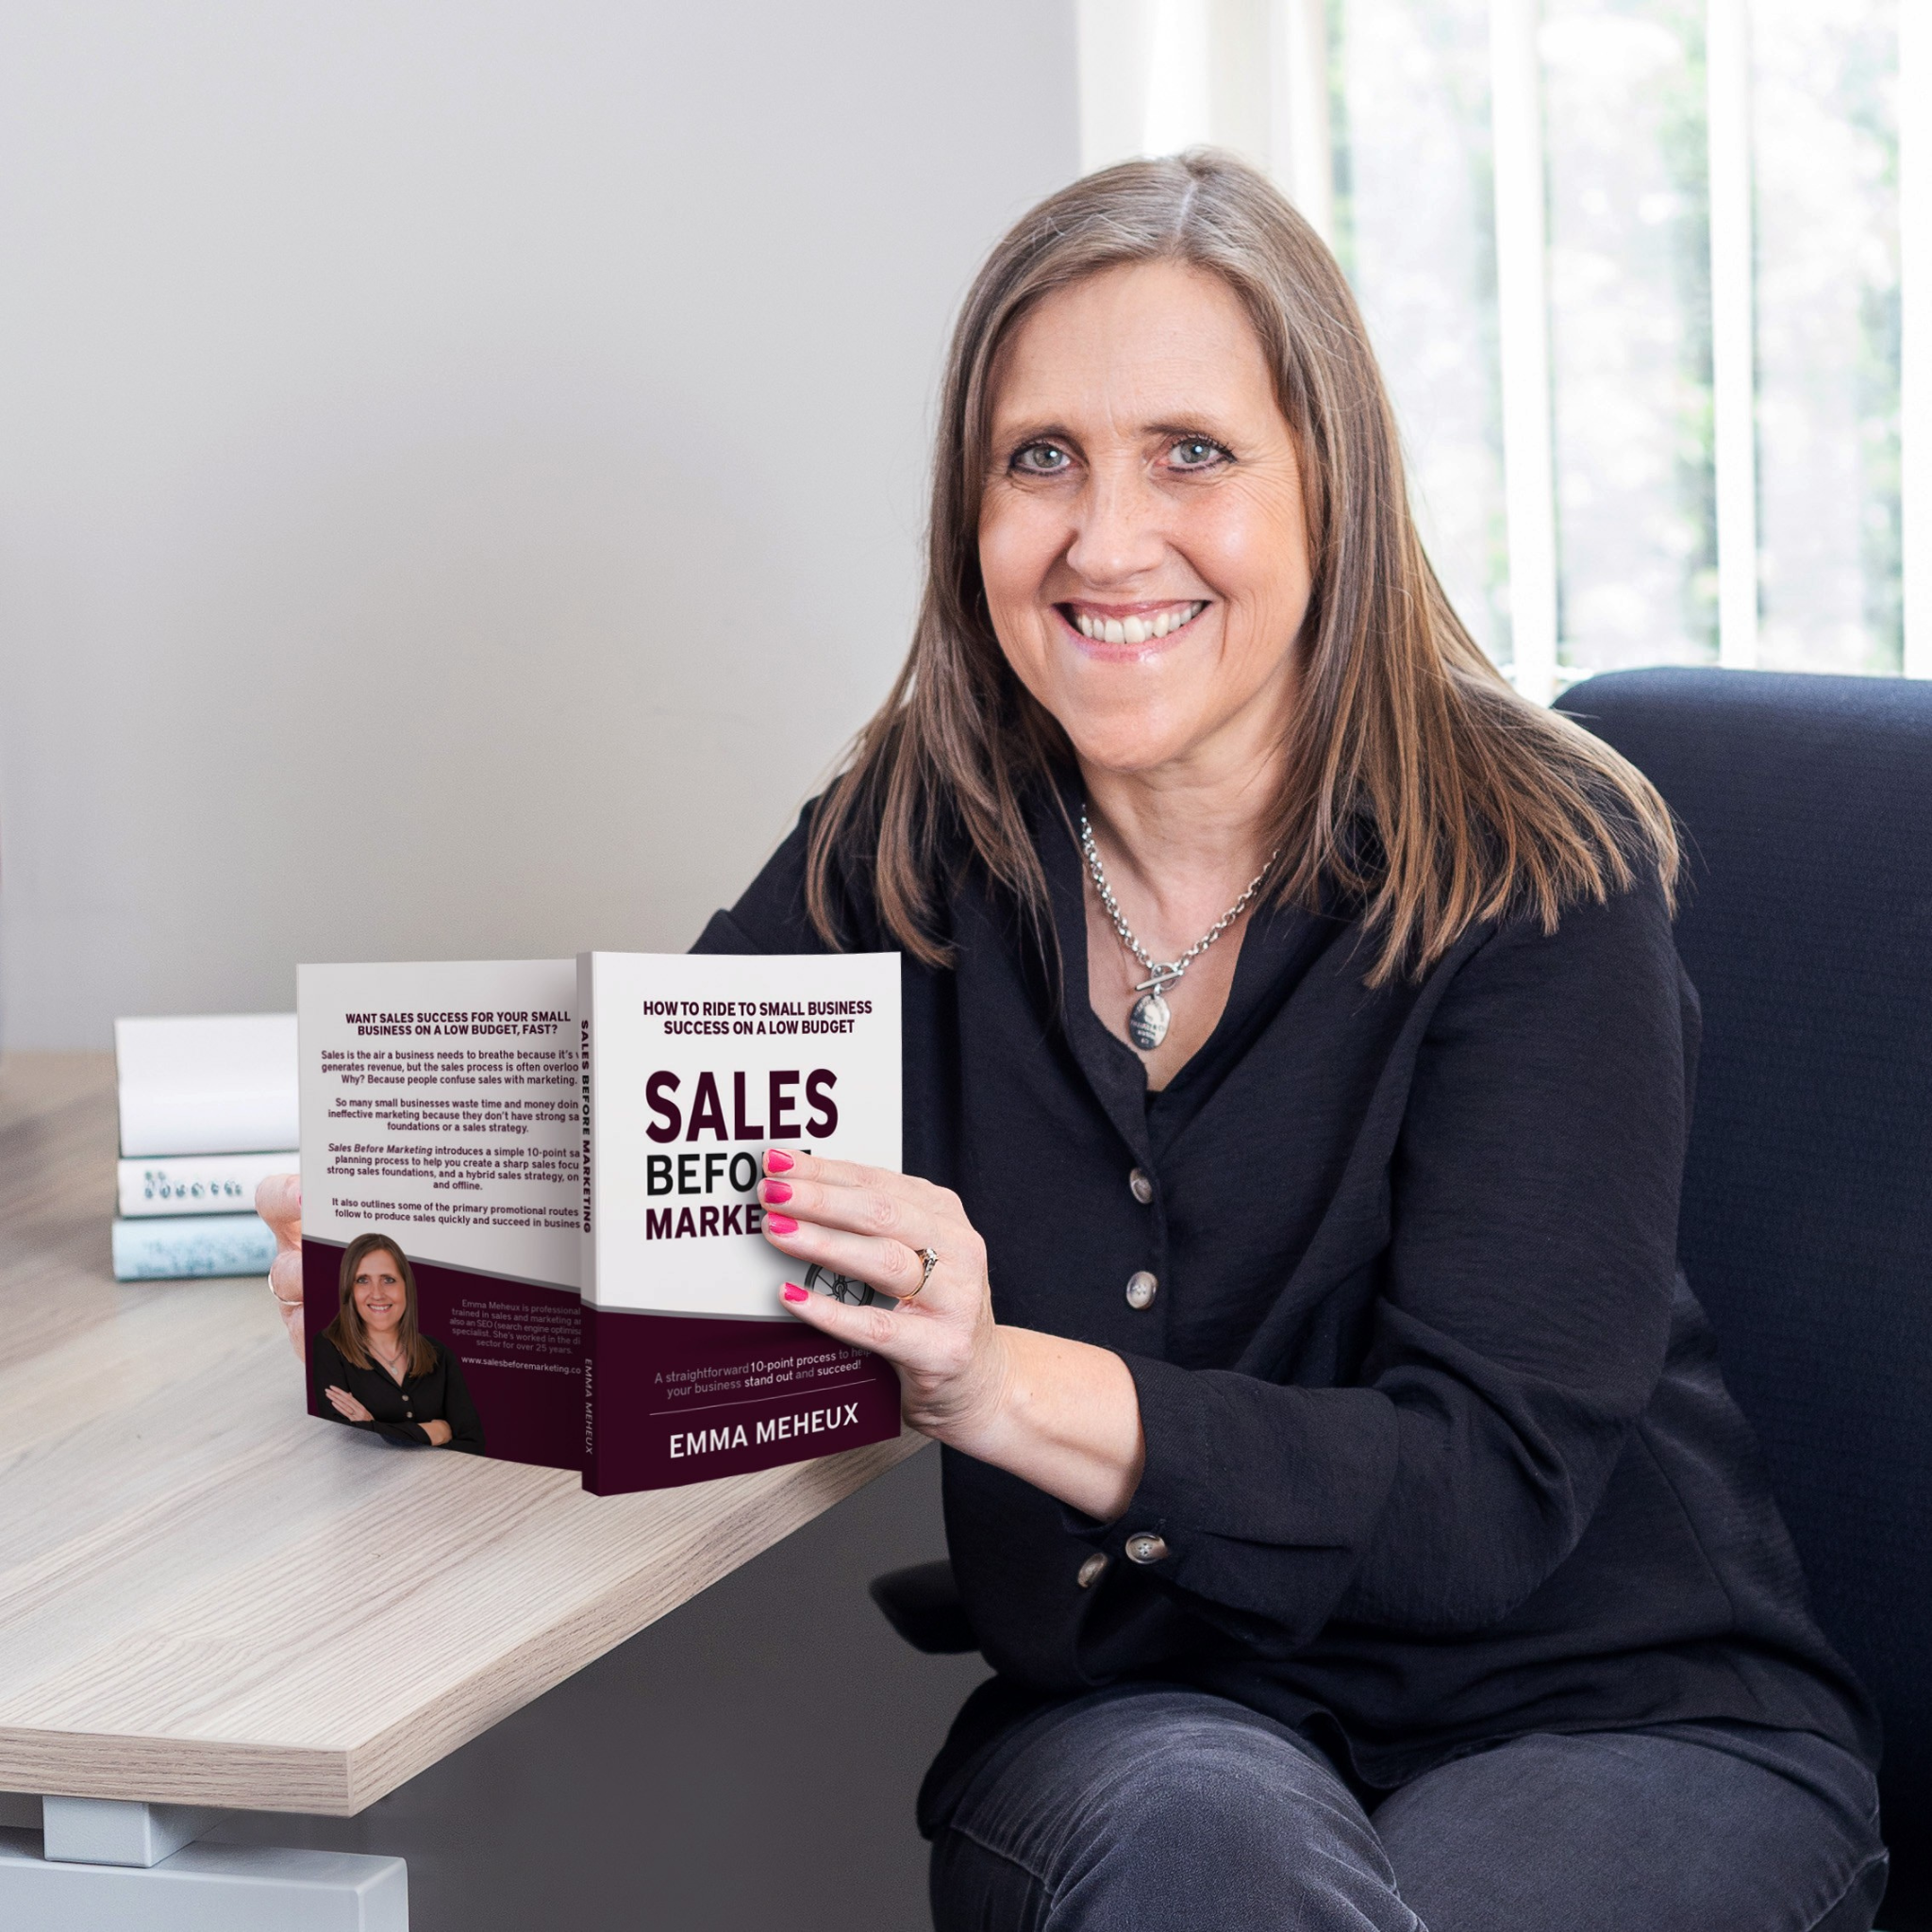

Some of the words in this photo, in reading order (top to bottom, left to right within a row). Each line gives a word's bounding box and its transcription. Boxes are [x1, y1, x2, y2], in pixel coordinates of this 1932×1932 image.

[643, 1001, 678, 1016] HOW
[680, 1001, 699, 1016] TO
[703, 1002, 736, 1016] RIDE
[738, 1002, 757, 1016] TO
[759, 1002, 805, 1016] SMALL
[808, 1000, 873, 1016] BUSINESS
[345, 1013, 377, 1024] WANT
[379, 1012, 414, 1024] SALES
[416, 1012, 469, 1024] SUCCESS
[471, 1011, 494, 1023] FOR
[496, 1011, 528, 1023] YOUR
[531, 1010, 571, 1022] SMALL
[358, 1024, 412, 1036] BUSINESS
[414, 1024, 431, 1035] ON
[433, 1024, 441, 1035] A
[444, 1024, 469, 1035] LOW
[472, 1024, 520, 1036] BUDGET,
[523, 1024, 558, 1035] FAST?
[664, 1021, 729, 1035] SUCCESS
[733, 1021, 753, 1035] ON
[756, 1021, 766, 1035] A
[769, 1020, 799, 1035] LOW
[802, 1019, 855, 1034] BUDGET
[581, 1020, 590, 1070] SALES
[321, 1050, 345, 1059] Sales
[346, 1050, 355, 1059] is
[357, 1050, 371, 1059] the
[373, 1050, 385, 1059] air
[395, 1050, 434, 1059] business
[437, 1050, 464, 1059] needs
[466, 1050, 476, 1059] to
[478, 1050, 514, 1059] breathe
[517, 1050, 557, 1059] because
[558, 1050, 574, 1059] it's
[321, 1062, 365, 1074] generates
[367, 1064, 405, 1073] revenue,
[407, 1062, 422, 1072] but
[424, 1062, 439, 1072] the
[441, 1062, 464, 1072] sales
[467, 1064, 503, 1074] process
[506, 1062, 513, 1072] is
[516, 1062, 541, 1072] often
[341, 1074, 365, 1086] Why?
[367, 1074, 406, 1084] Because
[408, 1074, 438, 1086] people
[440, 1074, 475, 1084] confuse
[478, 1074, 502, 1084] sales
[504, 1074, 525, 1084] with
[526, 1074, 577, 1087] marketing.
[335, 1097, 347, 1107] So
[349, 1099, 373, 1109] many
[375, 1098, 398, 1108] small
[400, 1098, 450, 1108] businesses
[452, 1099, 478, 1108] waste
[481, 1099, 502, 1108] time
[504, 1099, 522, 1108] and
[524, 1101, 556, 1111] money
[582, 1074, 591, 1135] BEFORE
[645, 1068, 839, 1143] SALES
[328, 1109, 374, 1119] ineffective
[375, 1109, 420, 1122] marketing
[422, 1110, 460, 1120] because
[462, 1110, 482, 1122] they
[484, 1111, 508, 1121] don't
[511, 1111, 533, 1121] have
[535, 1111, 566, 1124] strong
[387, 1122, 441, 1131] foundations
[462, 1123, 487, 1132] sales
[489, 1123, 528, 1135] strategy.
[328, 1142, 352, 1153] Sales
[354, 1143, 384, 1154] Before
[386, 1144, 433, 1157] Marketing
[435, 1146, 484, 1156] introduces
[493, 1147, 525, 1158] simple
[527, 1147, 567, 1159] 10-point
[335, 1155, 373, 1166] planning
[375, 1158, 409, 1166] process
[411, 1157, 421, 1166] to
[423, 1158, 442, 1168] help
[444, 1159, 461, 1169] you
[462, 1158, 492, 1168] create
[503, 1158, 529, 1171] sharp
[531, 1159, 556, 1170] sales
[326, 1165, 355, 1176] strong
[357, 1166, 380, 1175] sales
[381, 1167, 437, 1178] foundations,
[439, 1169, 456, 1178] and
[466, 1170, 495, 1180] hybrid
[497, 1171, 522, 1180] sales
[524, 1171, 565, 1183] strategy,
[433, 1180, 450, 1190] and
[452, 1180, 483, 1191] offline.
[583, 1140, 591, 1233] MARKETING
[332, 1197, 339, 1206] It
[341, 1198, 358, 1208] also
[360, 1200, 396, 1209] outlines
[398, 1203, 422, 1211] some
[424, 1202, 433, 1211] of
[435, 1203, 450, 1212] the
[453, 1203, 489, 1215] primary
[491, 1206, 547, 1215] promotional
[548, 1208, 579, 1217] routes
[335, 1208, 361, 1218] follow
[363, 1210, 373, 1219] to
[375, 1212, 410, 1222] produce
[412, 1213, 436, 1223] sales
[438, 1214, 471, 1226] quickly
[473, 1216, 490, 1224] and
[491, 1218, 530, 1226] succeed
[533, 1218, 541, 1227] in
[645, 1204, 762, 1241] MARKE
[461, 1299, 487, 1308] Emma
[489, 1301, 520, 1311] Meheux
[451, 1307, 480, 1318] trained
[491, 1311, 512, 1321] sales
[530, 1315, 572, 1326] marketing
[449, 1317, 465, 1325] also
[476, 1319, 493, 1328] SEO
[524, 1324, 550, 1334] engine
[452, 1327, 491, 1338] specialist.
[492, 1330, 514, 1340] She's
[515, 1334, 546, 1342] worked
[557, 1335, 571, 1344] the
[475, 1340, 501, 1348] sector
[503, 1341, 514, 1349] for
[536, 1343, 547, 1352] 25
[548, 1346, 573, 1355] years.
[654, 1372, 663, 1384] A
[666, 1362, 749, 1383] straightforward
[751, 1357, 793, 1373] 10-point
[796, 1353, 836, 1369] process
[839, 1349, 849, 1359] to
[667, 1385, 691, 1399] your
[695, 1379, 741, 1394] business
[744, 1373, 774, 1388] stand
[775, 1370, 793, 1383] out
[795, 1367, 814, 1379] and
[817, 1359, 860, 1376] succeed!
[585, 1402, 593, 1455] MEHEUX
[670, 1424, 749, 1458] EMMA
[756, 1402, 858, 1444] MEHEUX
